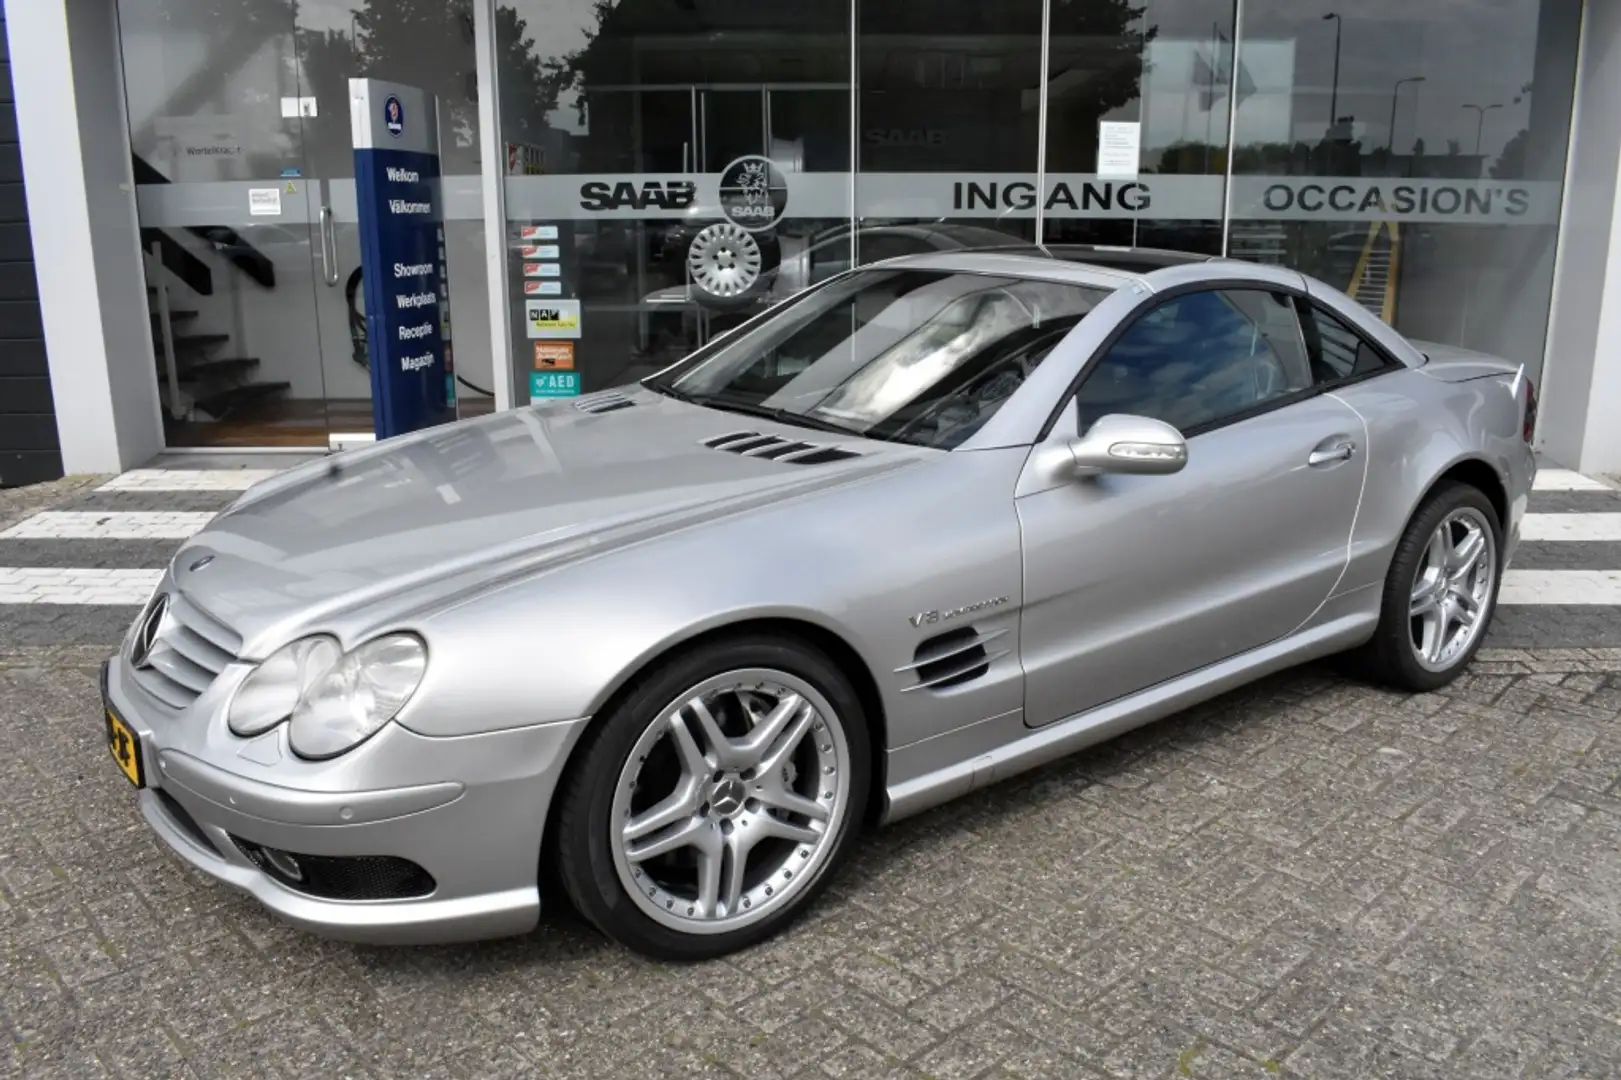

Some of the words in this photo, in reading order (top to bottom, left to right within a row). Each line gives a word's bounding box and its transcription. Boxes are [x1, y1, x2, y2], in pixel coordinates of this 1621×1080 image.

[386, 166, 420, 183] Welkom
[580, 181, 696, 211] SAAB
[954, 182, 1151, 211] INGANG
[1263, 184, 1530, 216] OCCASION'S
[731, 205, 775, 217] SAAB
[394, 263, 433, 278] Showroom
[399, 321, 433, 340] Receptie
[549, 375, 574, 388] AED
